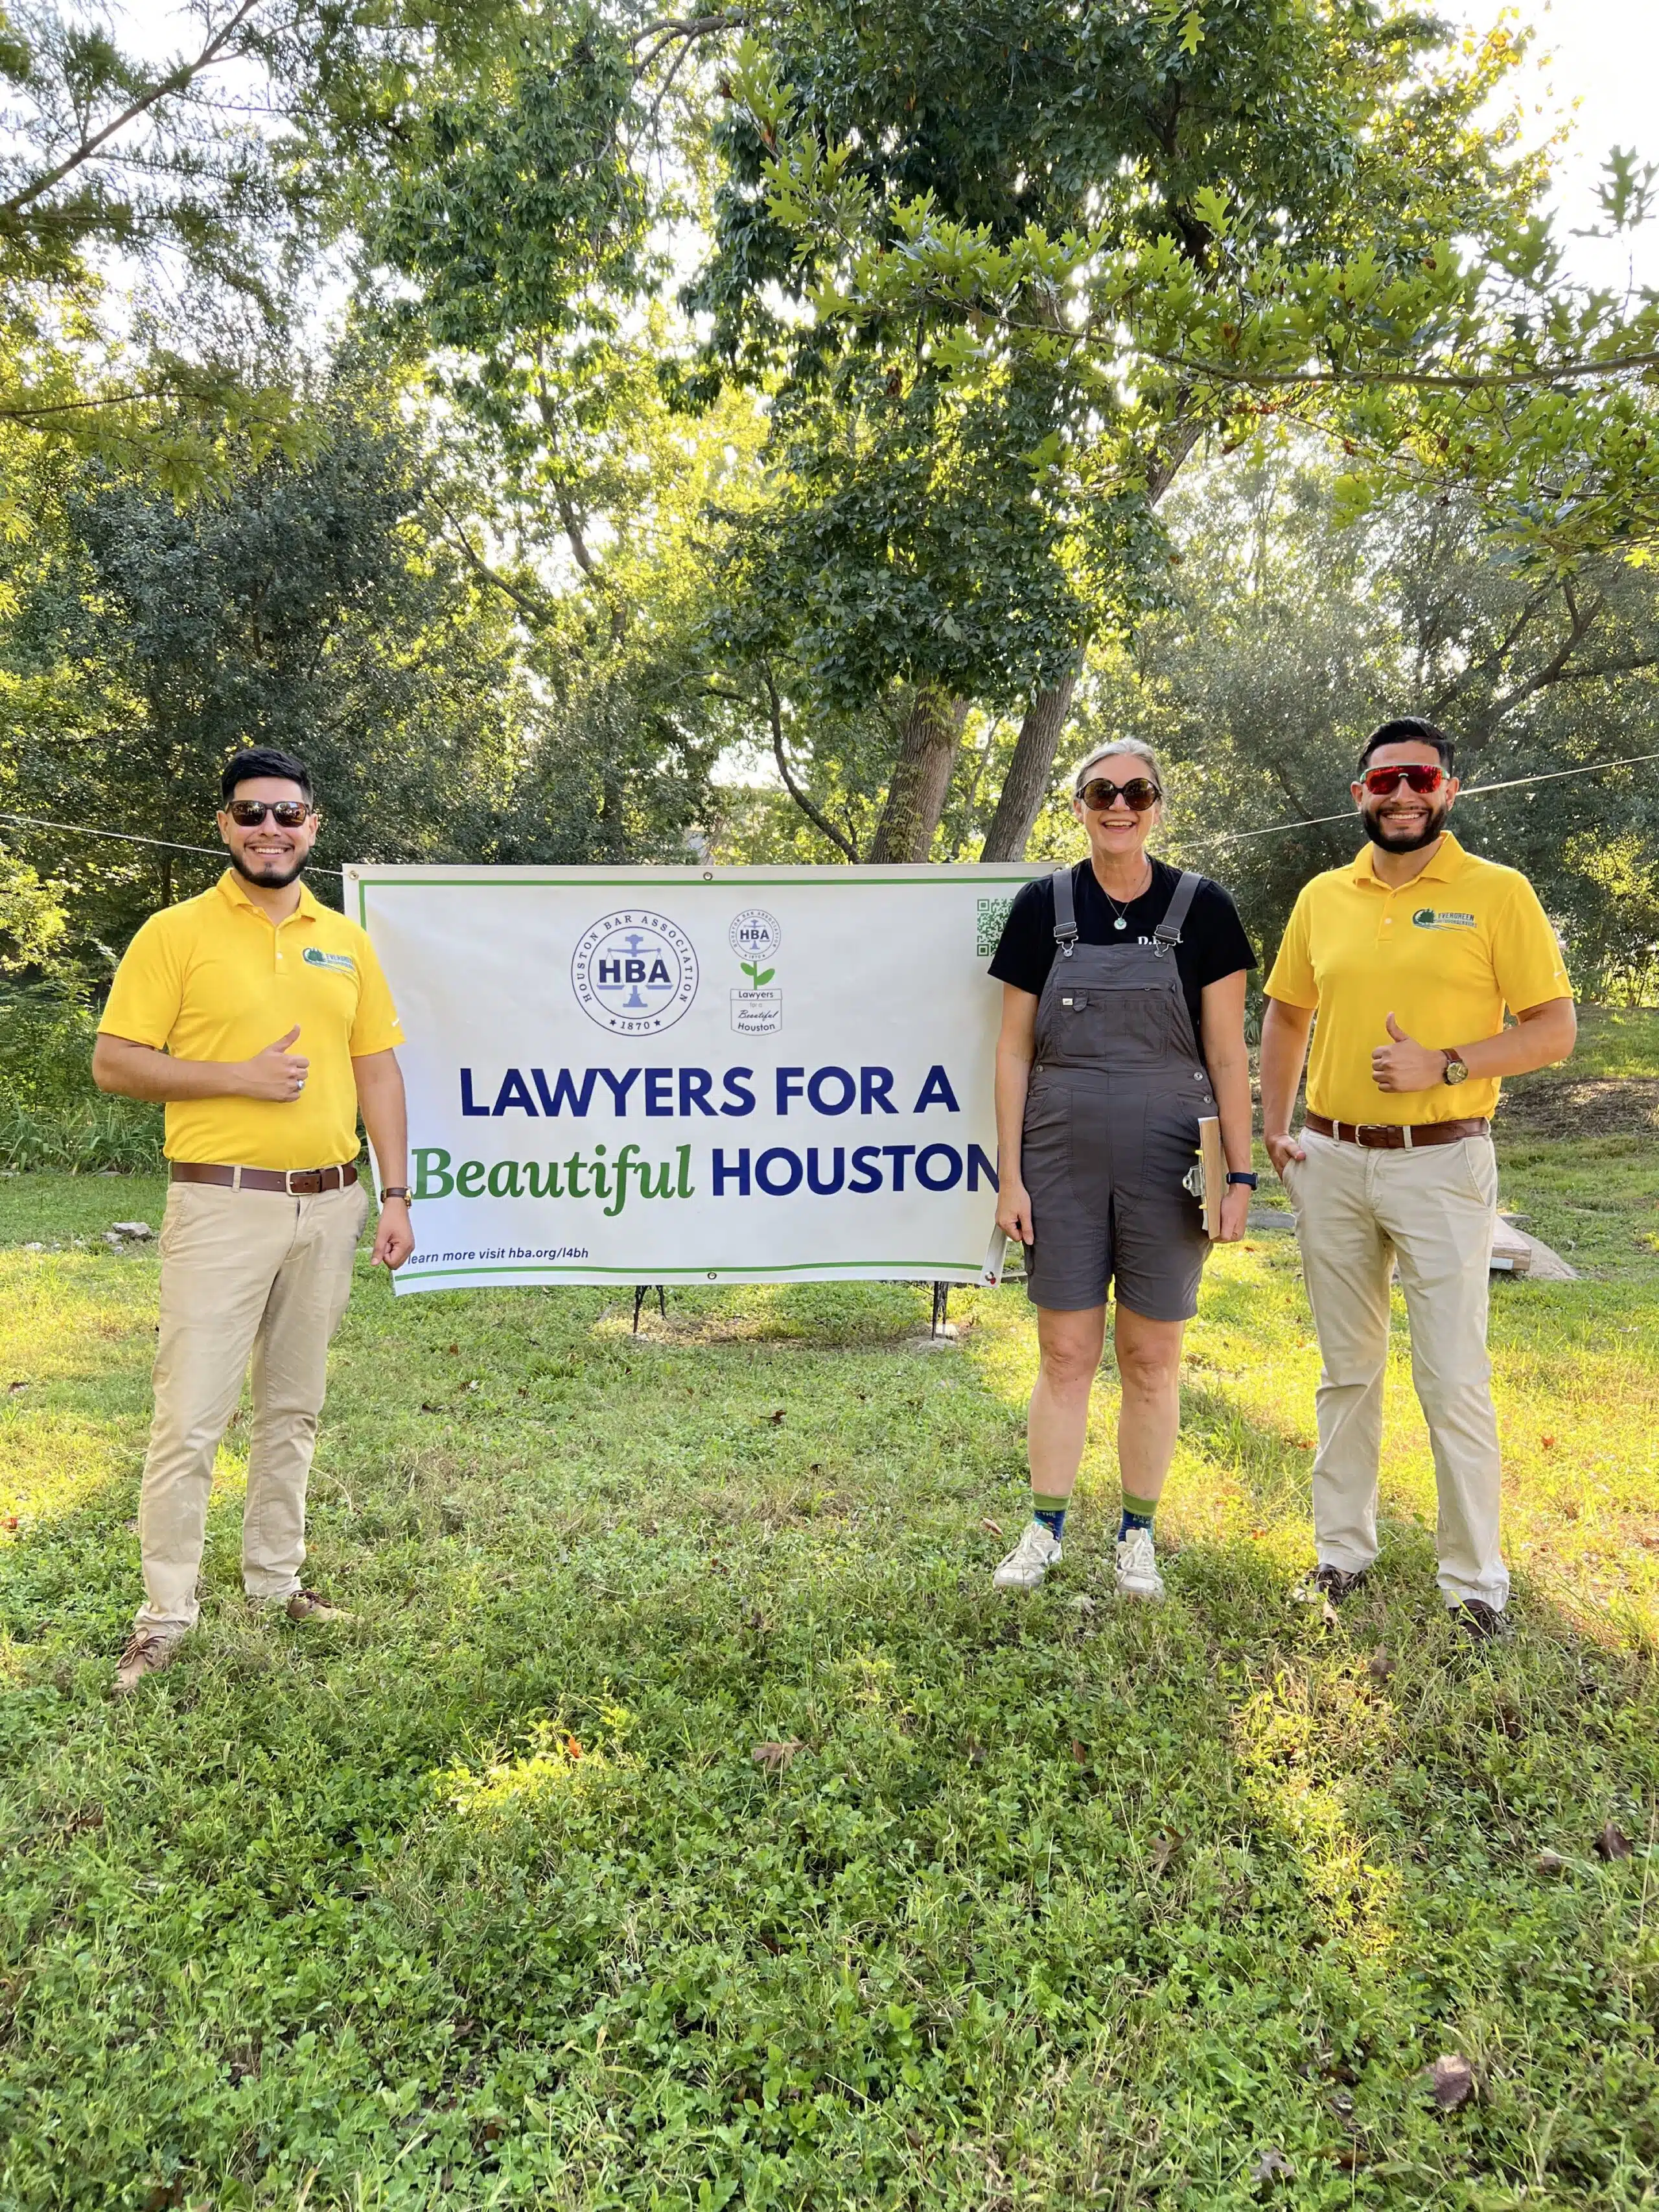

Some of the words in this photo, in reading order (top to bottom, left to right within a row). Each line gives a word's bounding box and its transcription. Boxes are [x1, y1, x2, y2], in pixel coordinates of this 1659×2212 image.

[740, 929, 769, 940] HBA
[577, 932, 599, 1003] HOUSTON
[603, 914, 632, 930] BAR
[641, 916, 693, 1003] ASSOCIATION
[599, 959, 671, 983] HBA
[738, 991, 774, 999] Lawyers
[737, 1009, 779, 1021] Beautiful
[620, 1021, 650, 1030] 1870
[737, 1022, 776, 1032] Houston
[459, 1066, 757, 1117] LAWYERS
[776, 1065, 900, 1116] FOR
[912, 1065, 961, 1113] A
[411, 1143, 695, 1217] Beautiful
[712, 1143, 1000, 1196] HOUSTON
[408, 1252, 439, 1264] learn
[442, 1250, 476, 1262] more
[479, 1248, 505, 1260] visit
[508, 1247, 589, 1261] hba.org/l4bh
